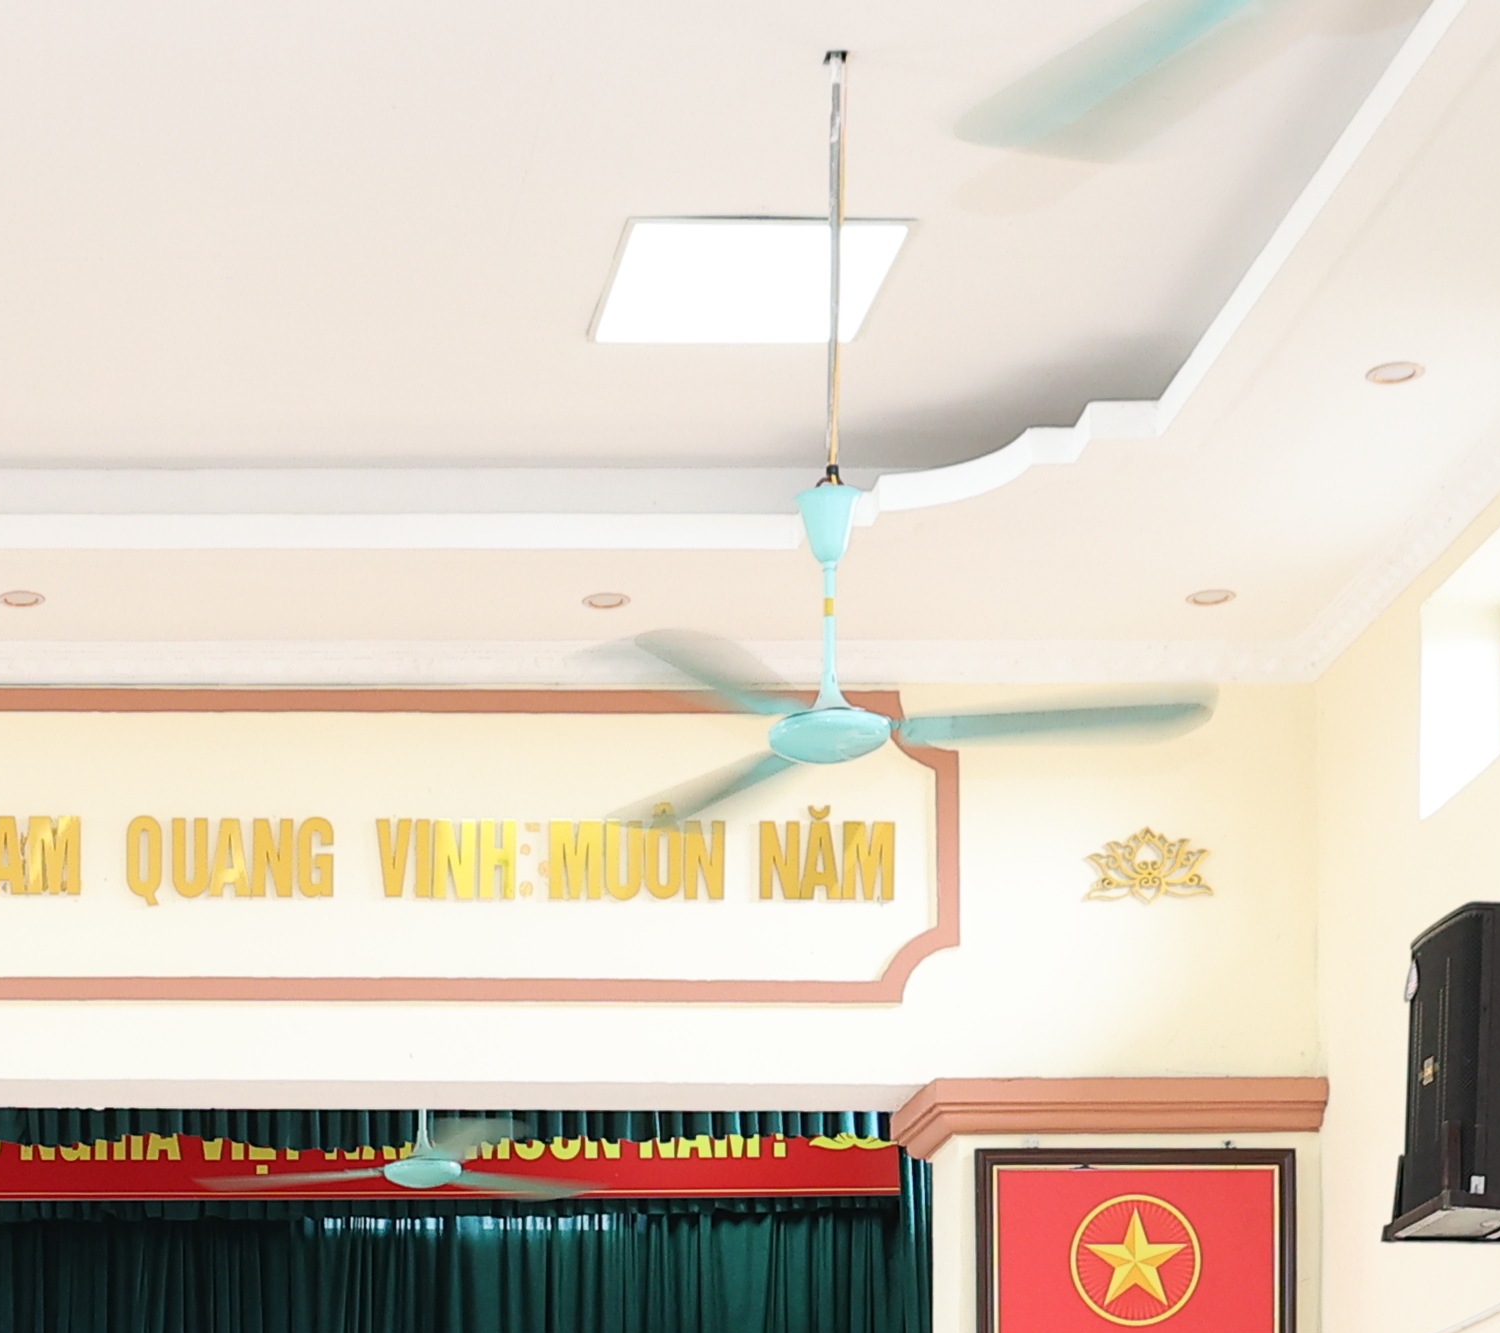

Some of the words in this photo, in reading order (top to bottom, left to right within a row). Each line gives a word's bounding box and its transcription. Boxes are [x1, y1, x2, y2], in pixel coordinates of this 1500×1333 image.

[126, 815, 334, 907] QUANG
[376, 817, 516, 901] VINH
[548, 802, 726, 901] MUÔN
[759, 805, 897, 902] NĂM
